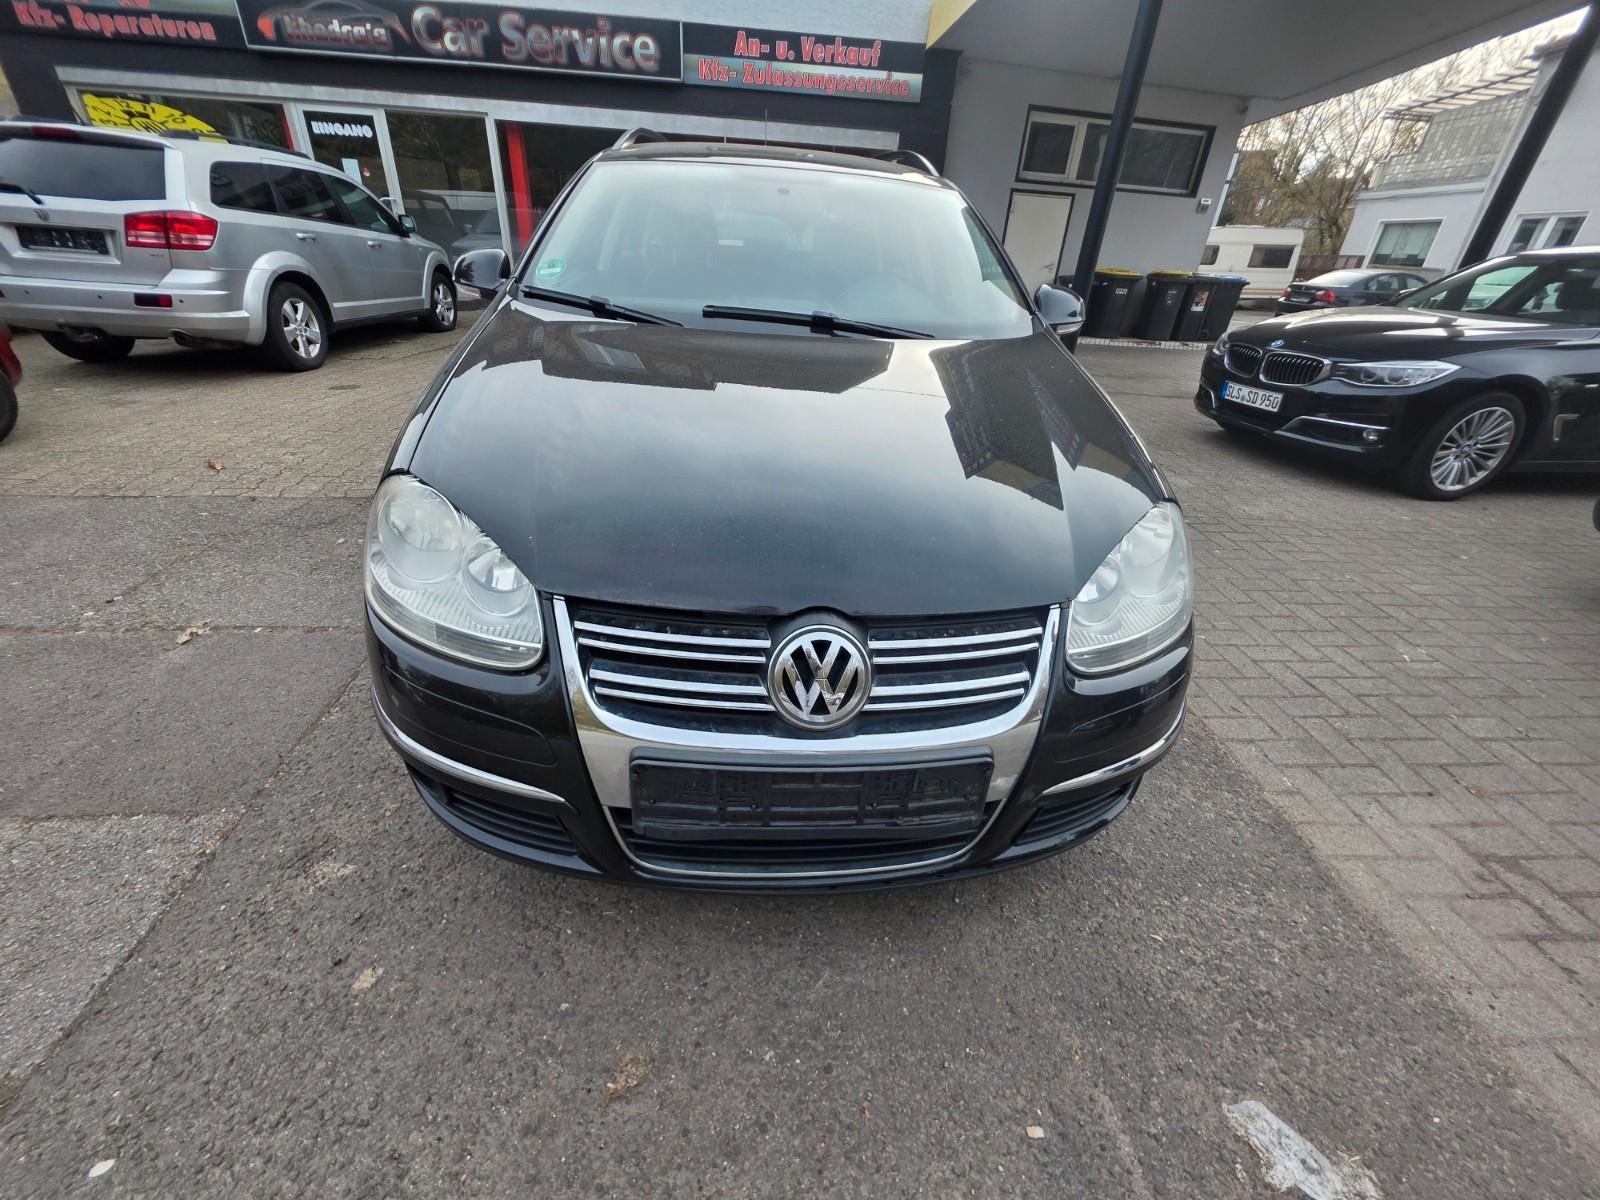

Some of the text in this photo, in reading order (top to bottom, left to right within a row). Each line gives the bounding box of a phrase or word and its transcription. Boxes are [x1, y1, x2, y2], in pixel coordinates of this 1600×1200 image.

[67, 5, 217, 41] Reparaturen
[411, 5, 489, 57] Car
[499, 11, 659, 71] Service
[734, 30, 881, 67] An- u. Verkauf
[698, 58, 910, 96] Kfz- Zulassungsservice
[1260, 393, 1279, 409] 950
